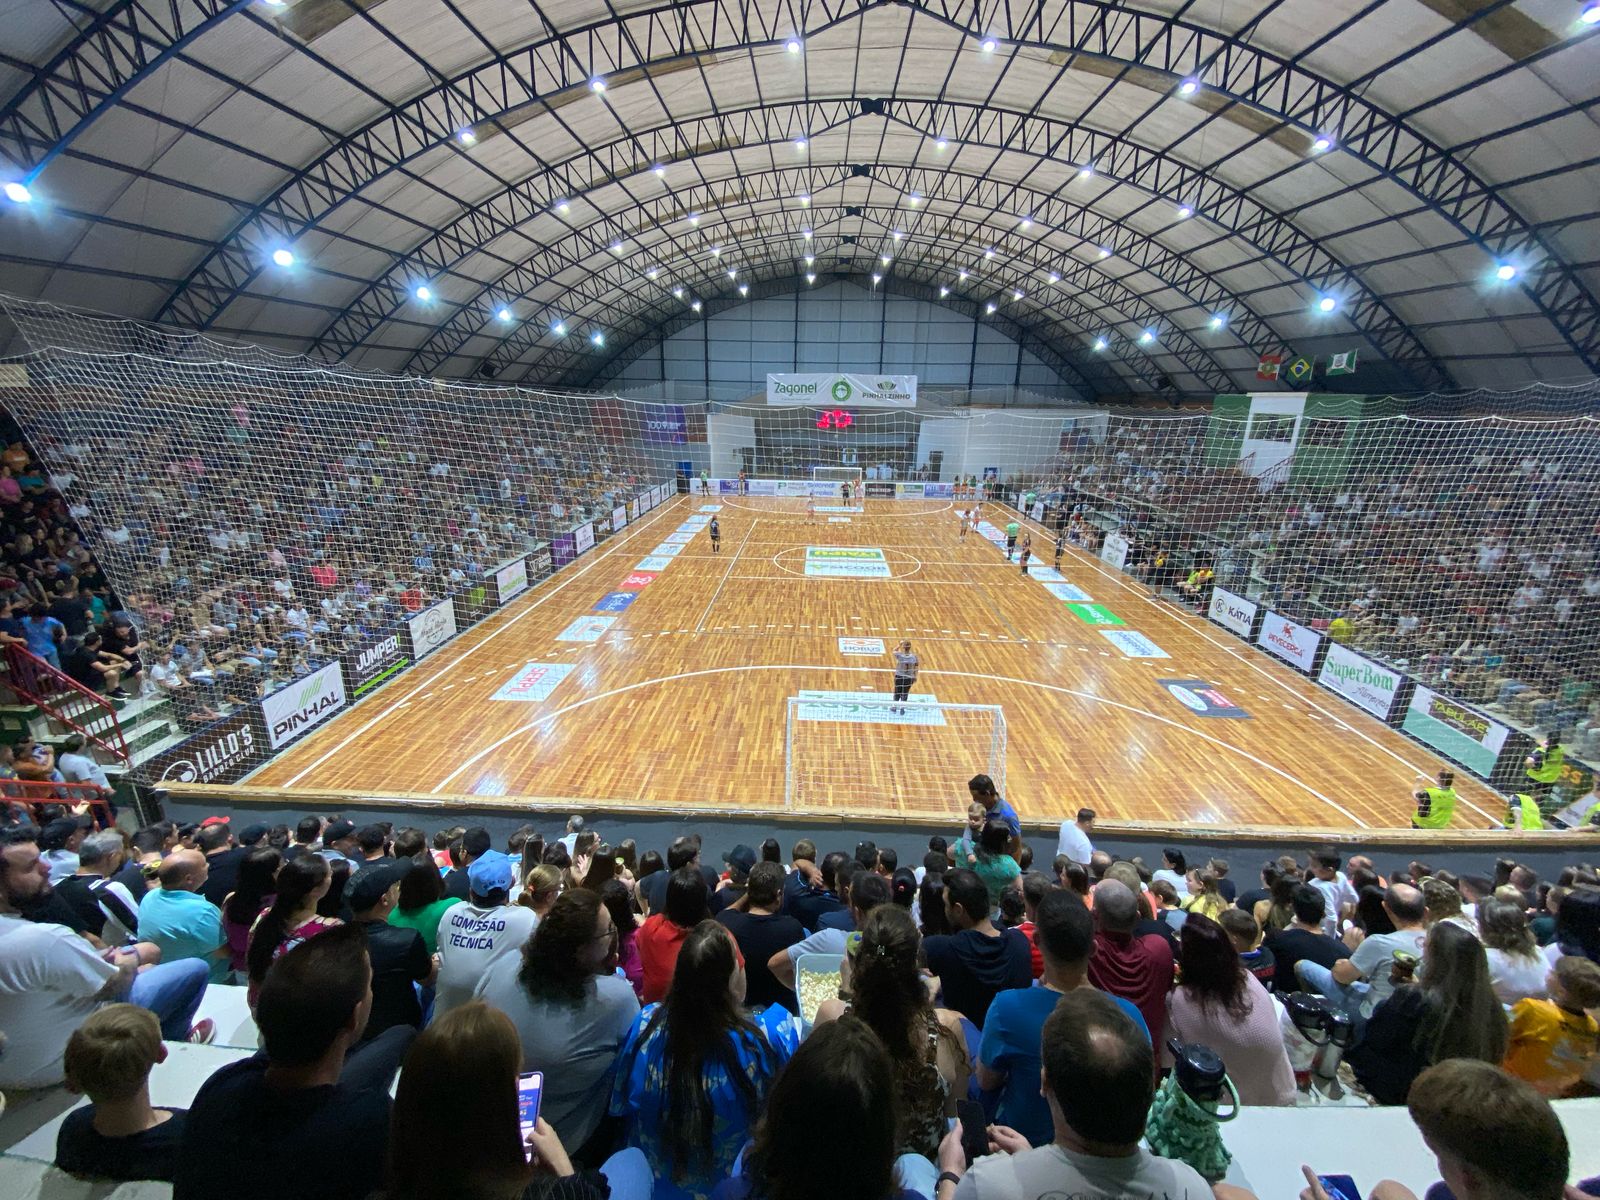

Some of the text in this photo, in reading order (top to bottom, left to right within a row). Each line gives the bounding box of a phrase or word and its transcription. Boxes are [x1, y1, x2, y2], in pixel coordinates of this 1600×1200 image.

[774, 382, 817, 396] Zagonel
[862, 392, 911, 400] PINHALZINHO
[1228, 606, 1251, 626] KÁTIA
[506, 667, 549, 695] SERPIL
[273, 691, 339, 741] PINHAL
[195, 724, 253, 774] LILLO'S
[451, 914, 506, 932] COMISSÃO
[449, 932, 493, 950] TÉCNICA
